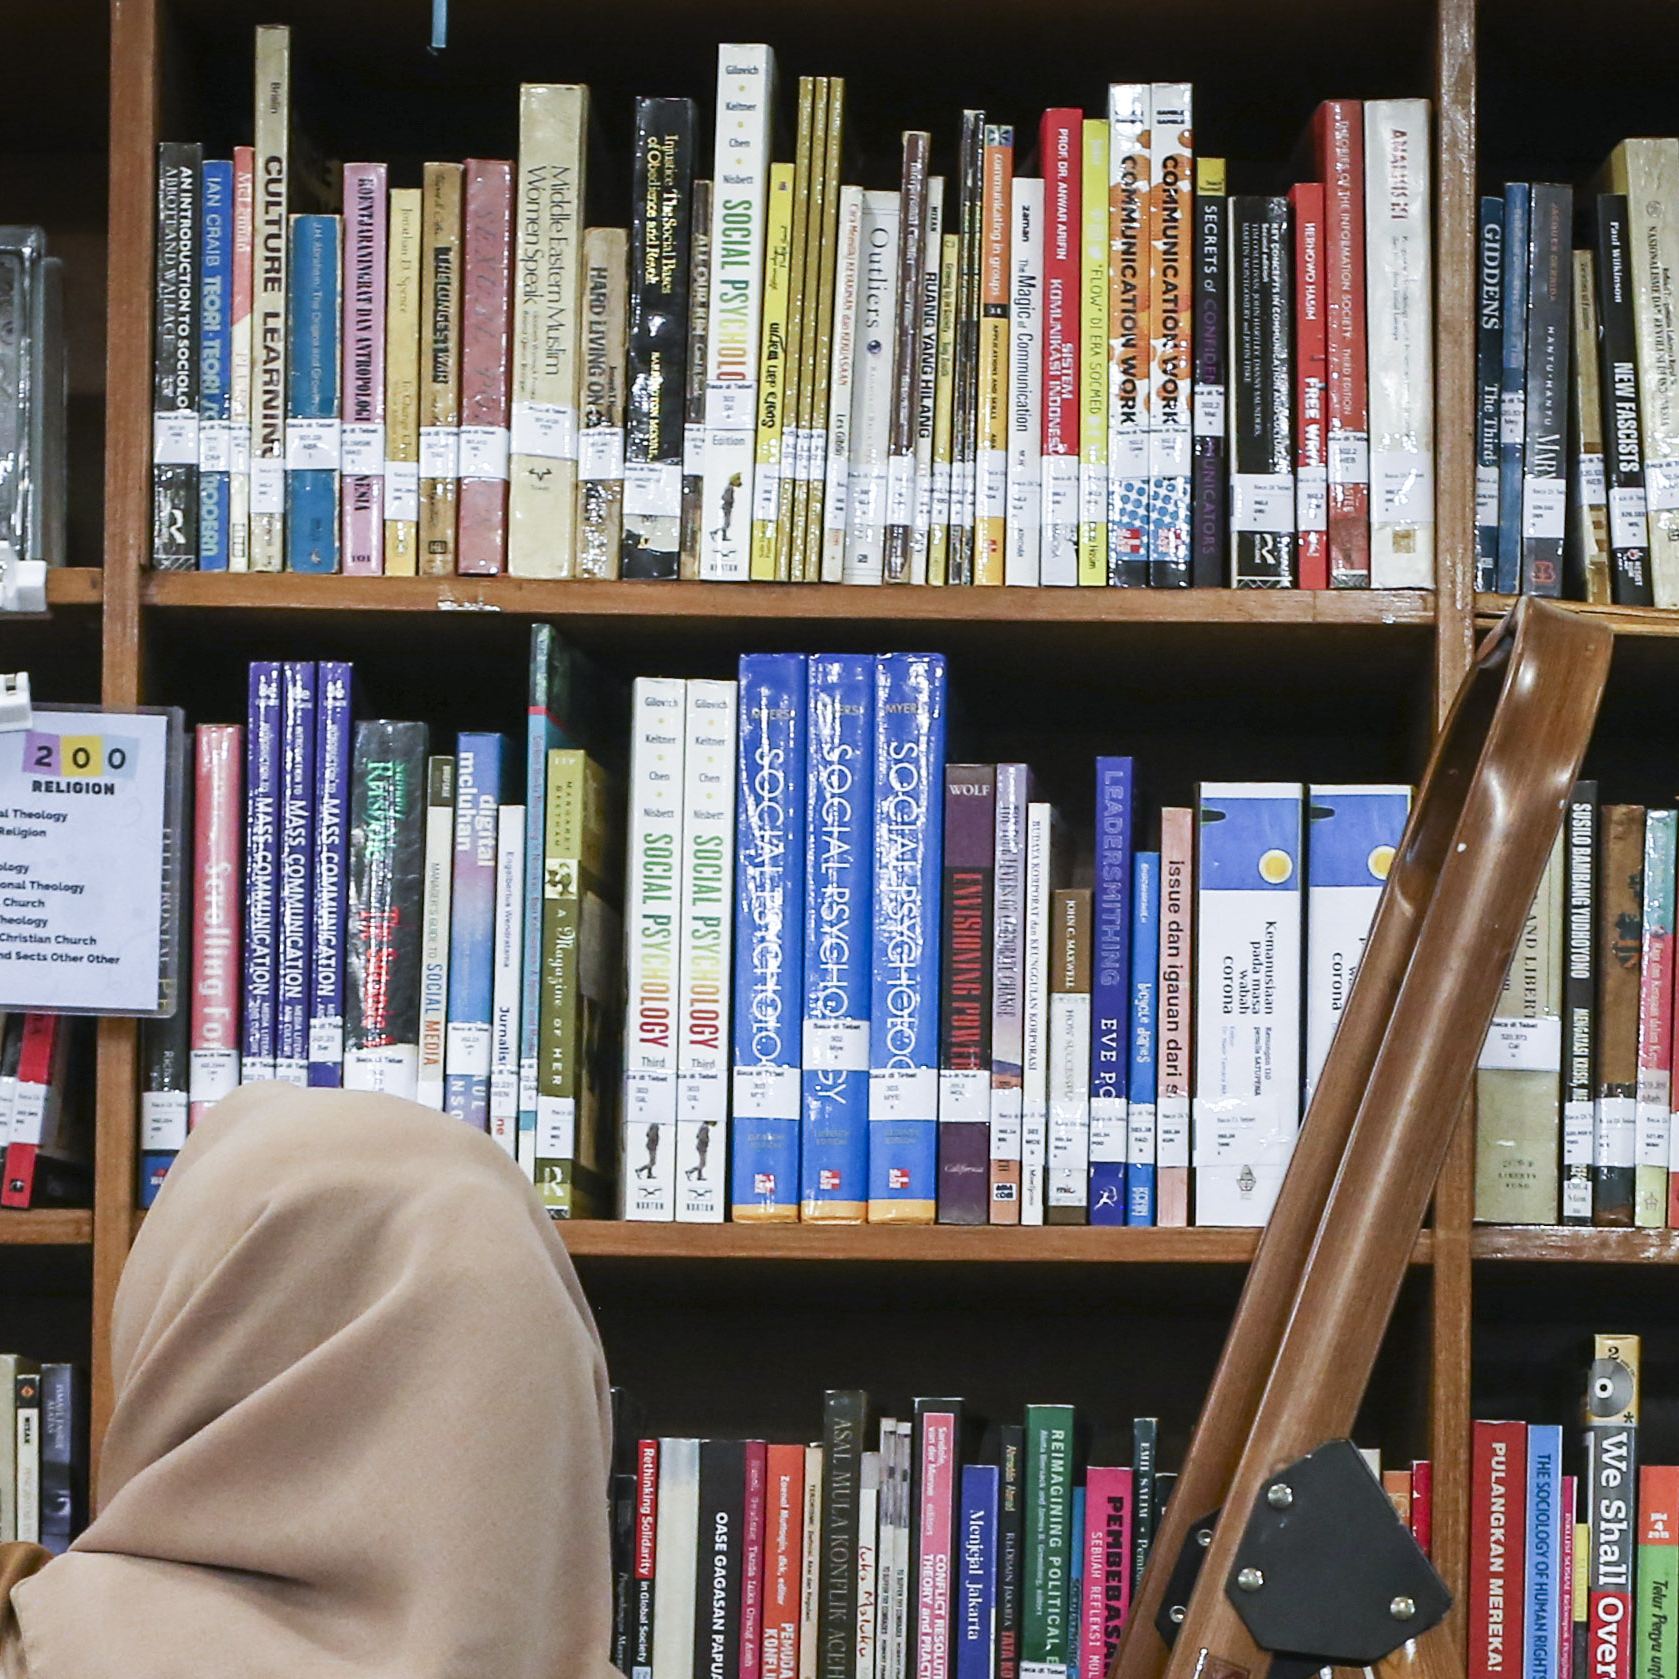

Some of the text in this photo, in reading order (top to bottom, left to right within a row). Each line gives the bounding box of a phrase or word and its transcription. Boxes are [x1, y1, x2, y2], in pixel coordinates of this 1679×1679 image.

[520, 166, 545, 304] Women Speak
[544, 165, 571, 376] Middle Eastern Muslim
[866, 227, 890, 328] Outliers
[1161, 155, 1178, 348] COMMUNICATION
[1483, 223, 1501, 329] GIDDENS
[1614, 362, 1638, 472] NEW FASCISTS
[13, 809, 68, 823] Theology
[31, 780, 115, 796] RELIGION
[456, 752, 476, 851] mcluhan
[476, 795, 497, 866] digital
[3, 898, 45, 908] Church
[30, 881, 84, 894] Theology
[1570, 803, 1591, 978] SUSILO BAMBANG YUDHOYONO
[0, 933, 51, 944] Christian
[55, 935, 96, 946] Church
[16, 952, 47, 961] Sects
[51, 953, 84, 963] Other
[88, 954, 120, 964] Other
[639, 834, 673, 1047] SOCIAL PSYCHOLOGY
[1599, 1432, 1628, 1488] We
[827, 1418, 852, 1679] ASAL MULA KONFLIK ACEH
[964, 1510, 984, 1640] Menjejal Jakarta
[1597, 1500, 1626, 1586] Shall
